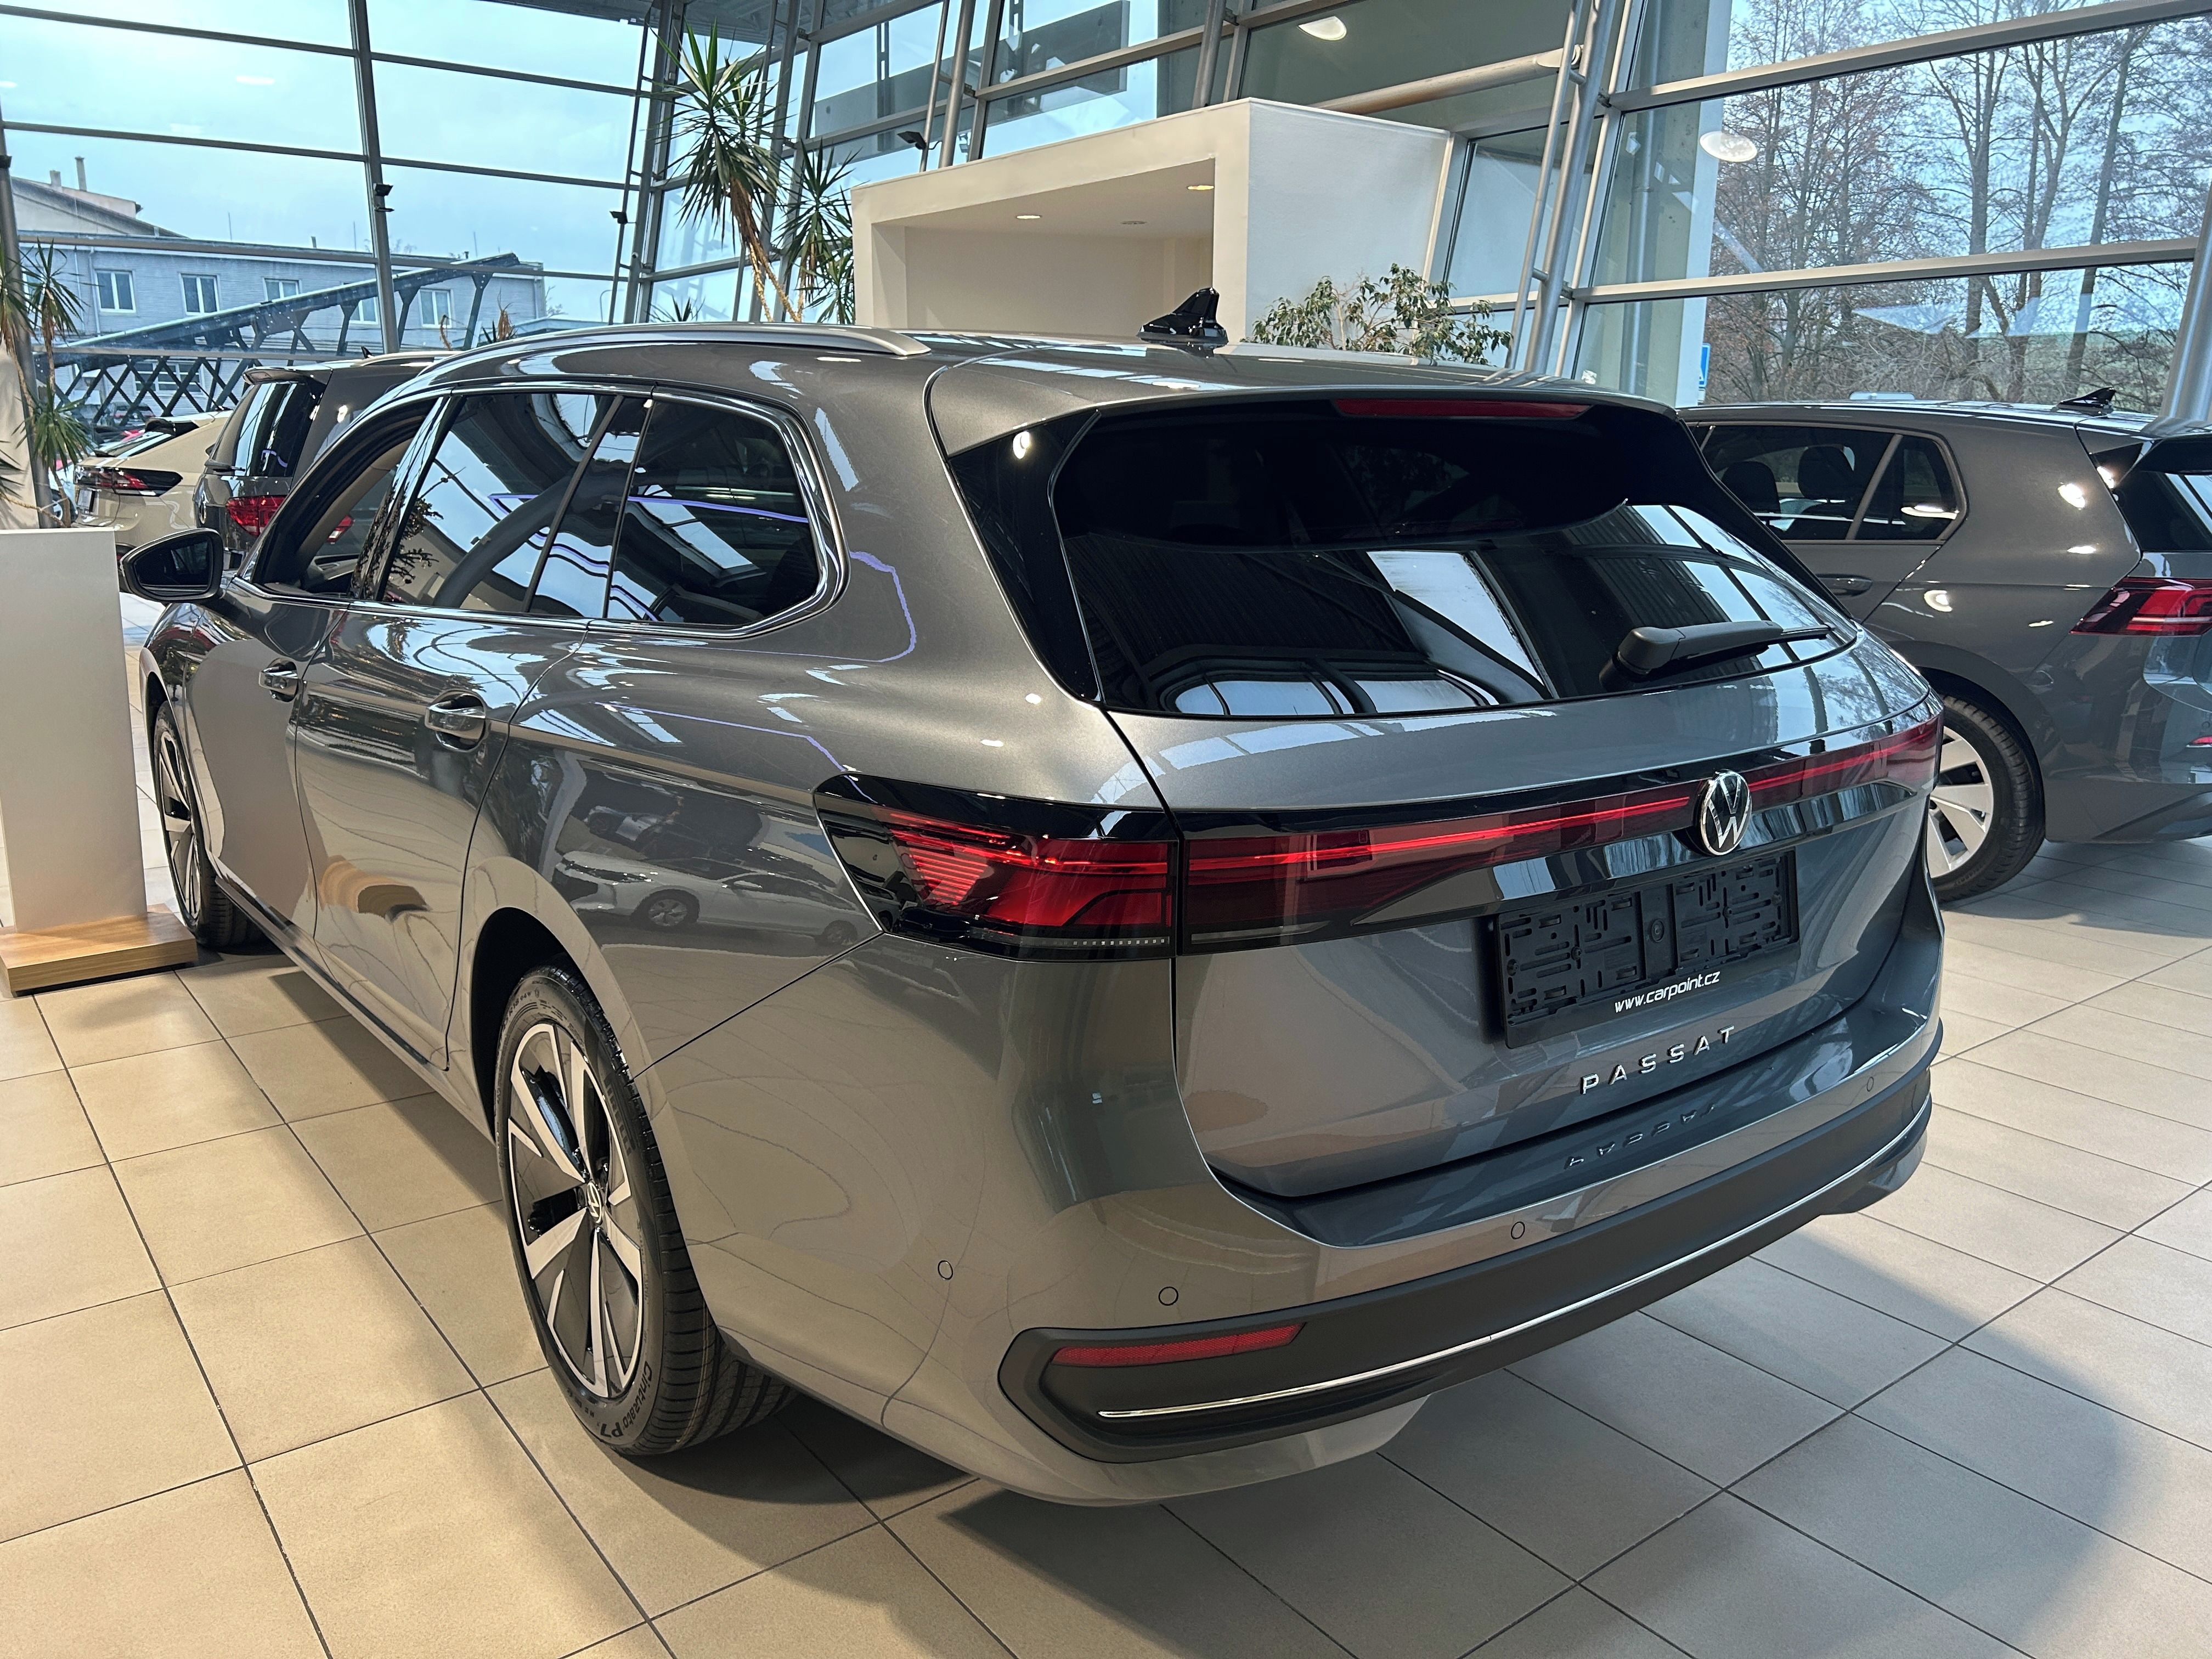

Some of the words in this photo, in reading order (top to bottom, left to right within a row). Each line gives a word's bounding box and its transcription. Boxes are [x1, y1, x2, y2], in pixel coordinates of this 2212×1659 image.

[1615, 971, 1720, 1013] www.carpoint.cz
[1580, 1025, 1734, 1094] PASSAT
[622, 1361, 652, 1429] Cinturato
[600, 1422, 624, 1438] P7
